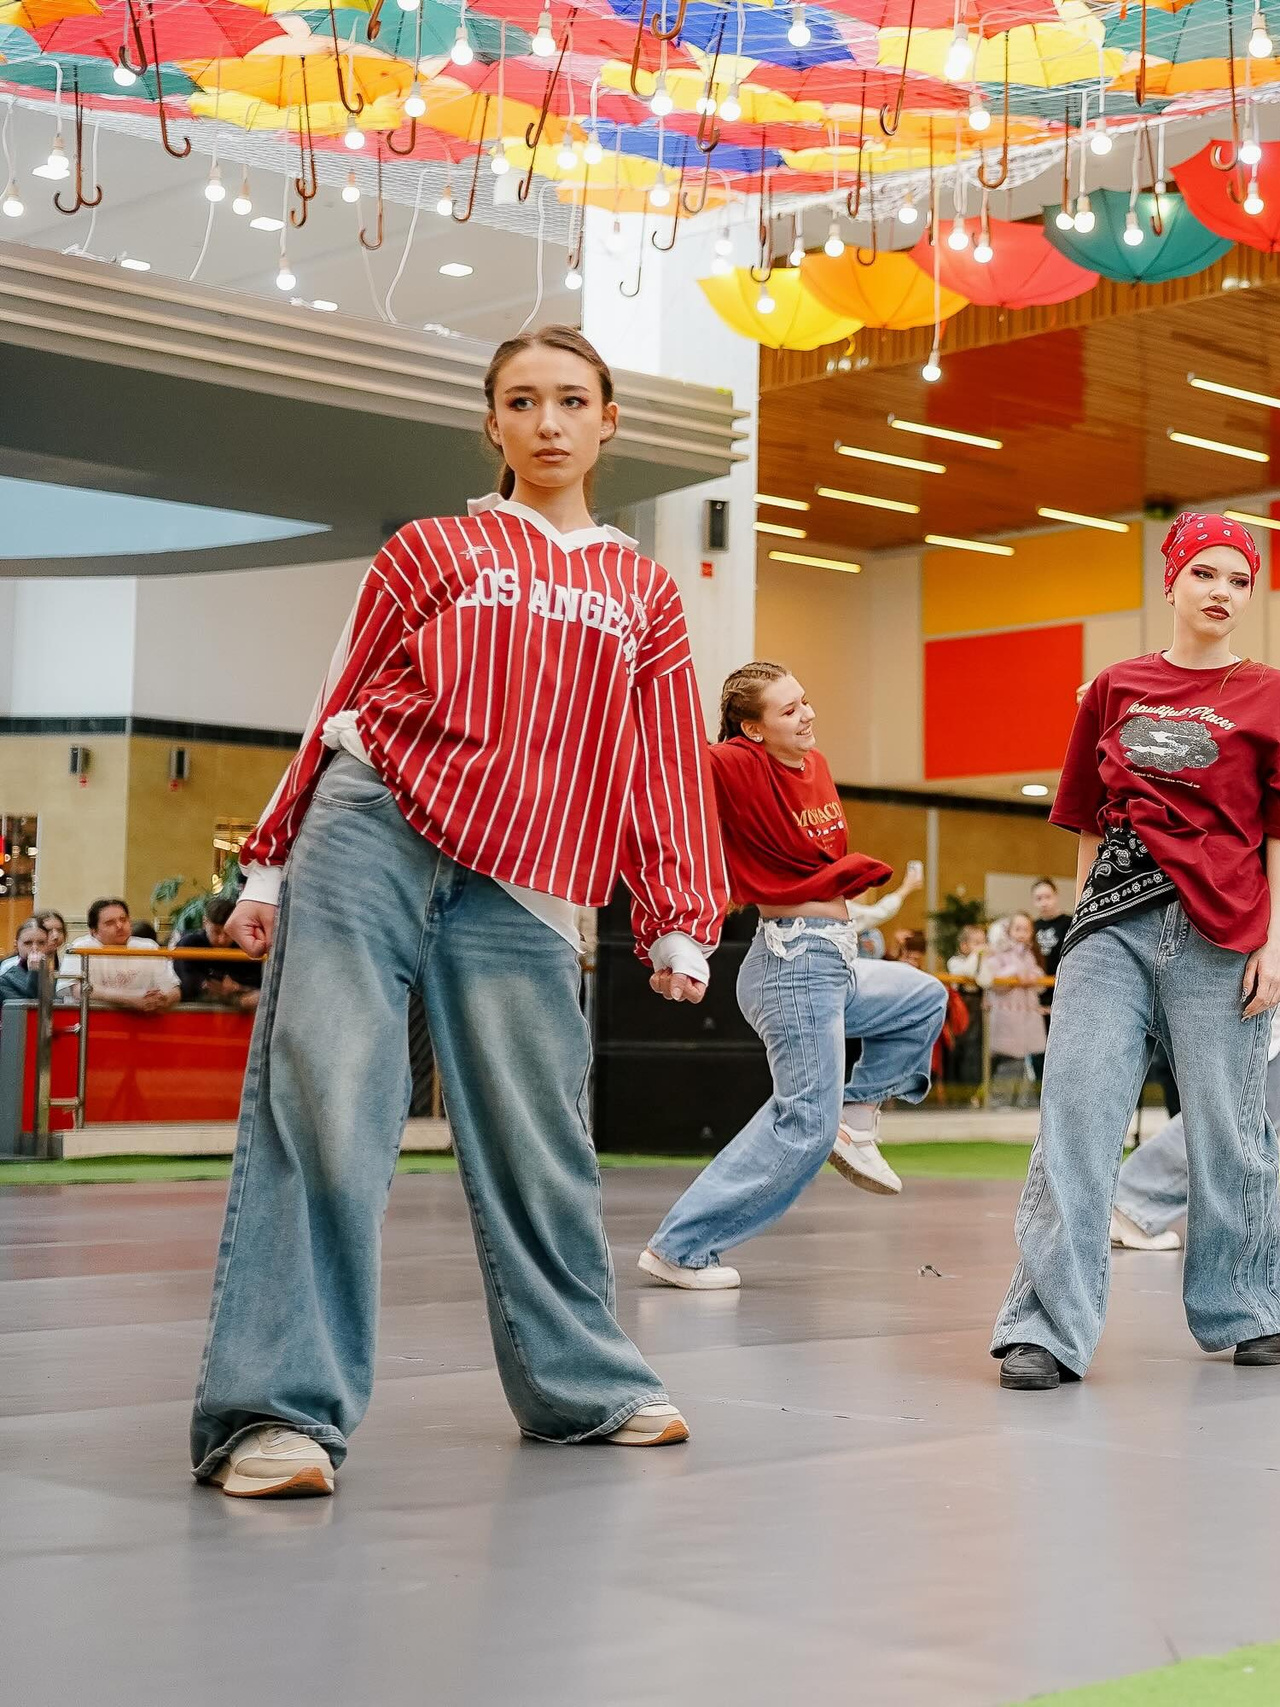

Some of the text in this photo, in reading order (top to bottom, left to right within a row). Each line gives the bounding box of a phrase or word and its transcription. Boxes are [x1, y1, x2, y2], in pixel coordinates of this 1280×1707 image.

[456, 568, 521, 608] LOS
[1129, 703, 1236, 730] eautiful Places
